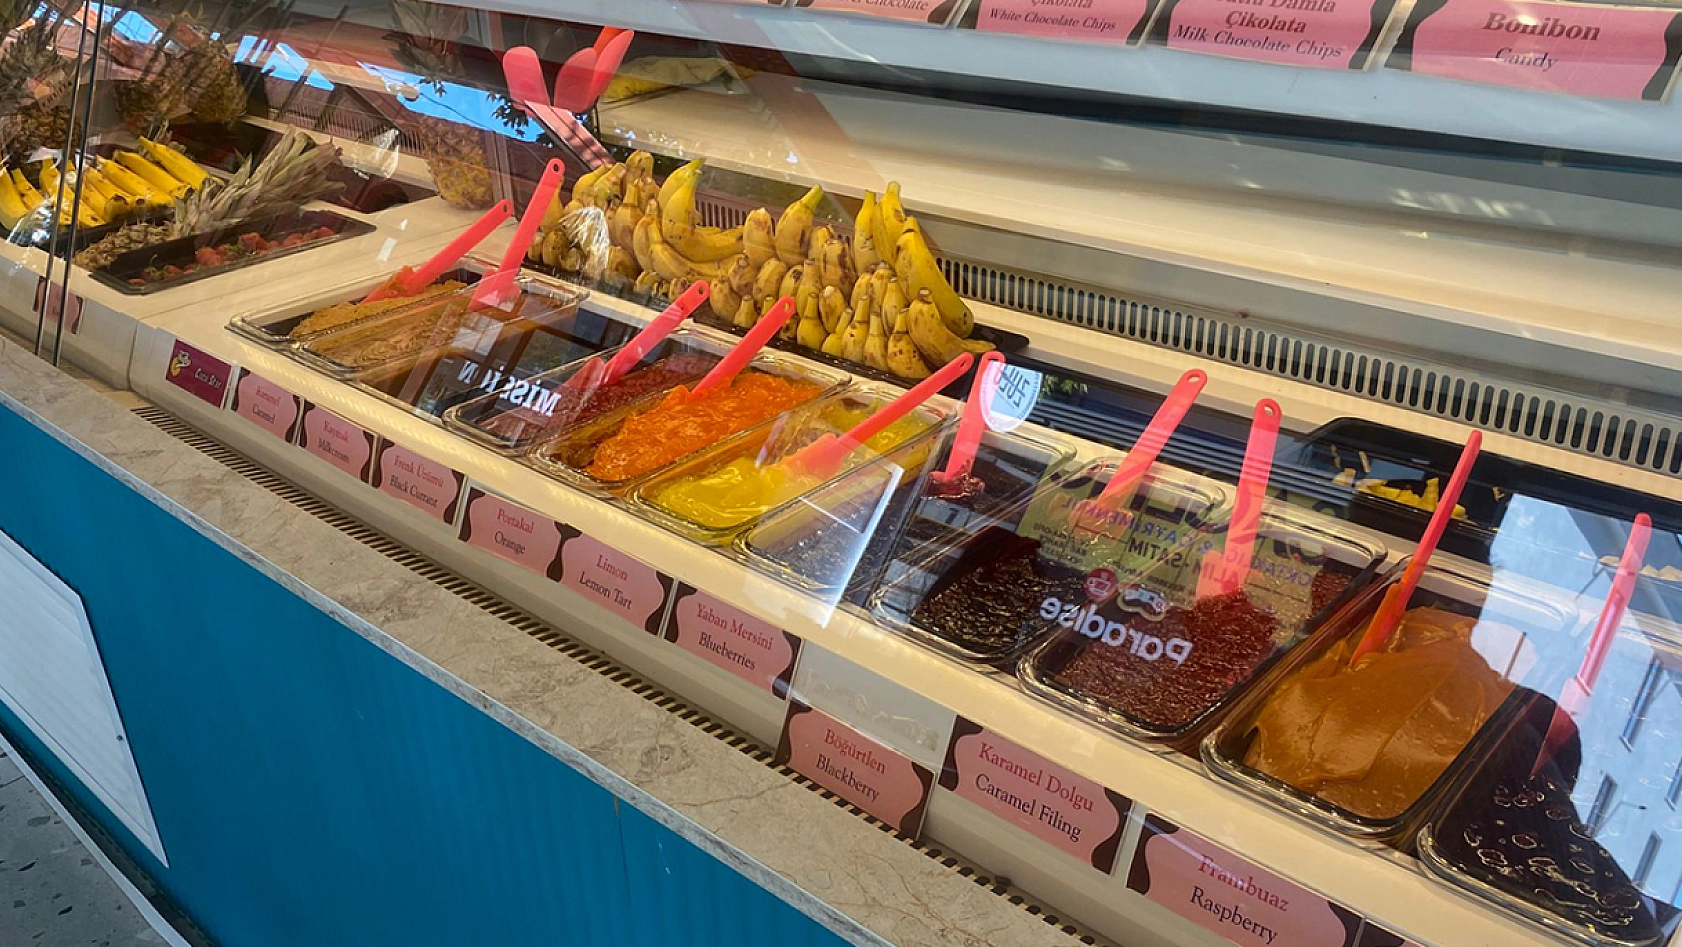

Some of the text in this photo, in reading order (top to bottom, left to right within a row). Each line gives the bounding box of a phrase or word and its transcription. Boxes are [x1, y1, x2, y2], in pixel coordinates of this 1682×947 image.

[989, 7, 1117, 34] White Chocolate Chips
[1225, 10, 1308, 34] Çikolata
[1173, 24, 1343, 60] Milk Chocolate Chips
[1495, 46, 1560, 73] Candy
[390, 474, 409, 493] Black
[496, 507, 534, 534] Portakal
[494, 531, 527, 556] Orange
[596, 554, 628, 581] Limon
[579, 570, 633, 610] Lemon Tart
[696, 602, 775, 651] Yaban Mersini
[698, 632, 756, 671] Blueberries
[823, 727, 886, 775] Böğürtlen
[815, 752, 880, 803] Blackberry
[978, 742, 1096, 813] Karamel Dolgu
[974, 771, 1083, 843] Caramel Filing
[1197, 853, 1289, 912] Frambuaz
[1189, 884, 1279, 945] Raspberry
